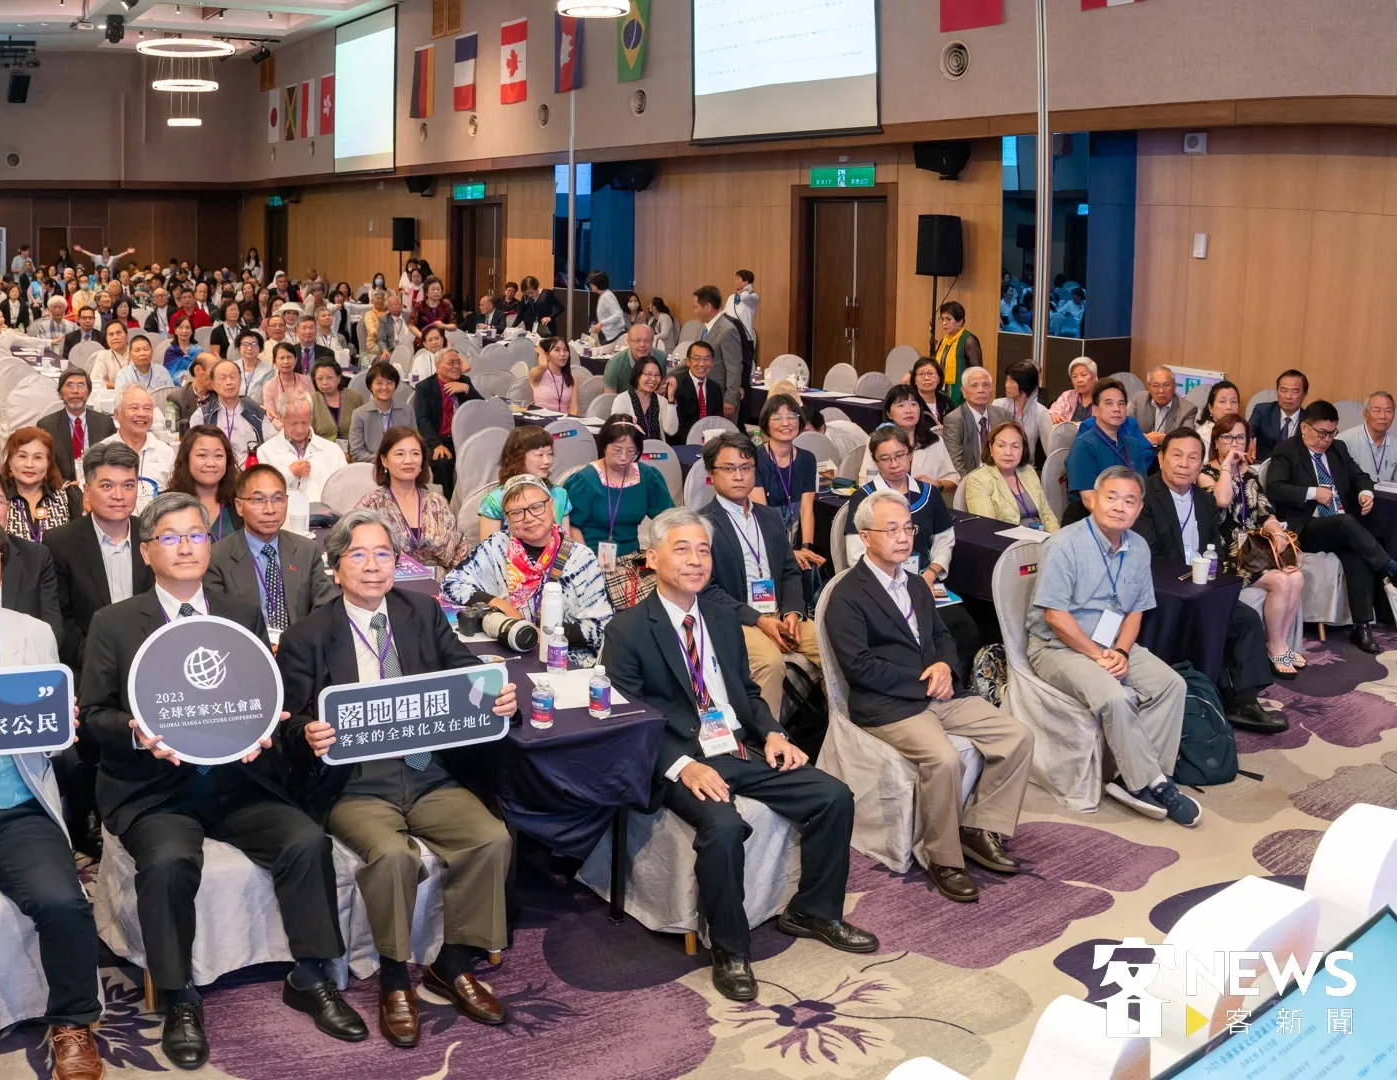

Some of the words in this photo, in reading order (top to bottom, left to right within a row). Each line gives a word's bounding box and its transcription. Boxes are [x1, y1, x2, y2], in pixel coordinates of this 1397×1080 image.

[155, 691, 185, 704] 2023
[158, 697, 263, 721] 全球客家文化會議
[338, 689, 449, 729] 落地生根
[159, 721, 182, 729] GLOBAL
[182, 719, 202, 727] HAKKA
[202, 717, 228, 725] CULTURE
[228, 713, 264, 722] CONFERENCE
[339, 713, 491, 748] 客家的全球化及在地化
